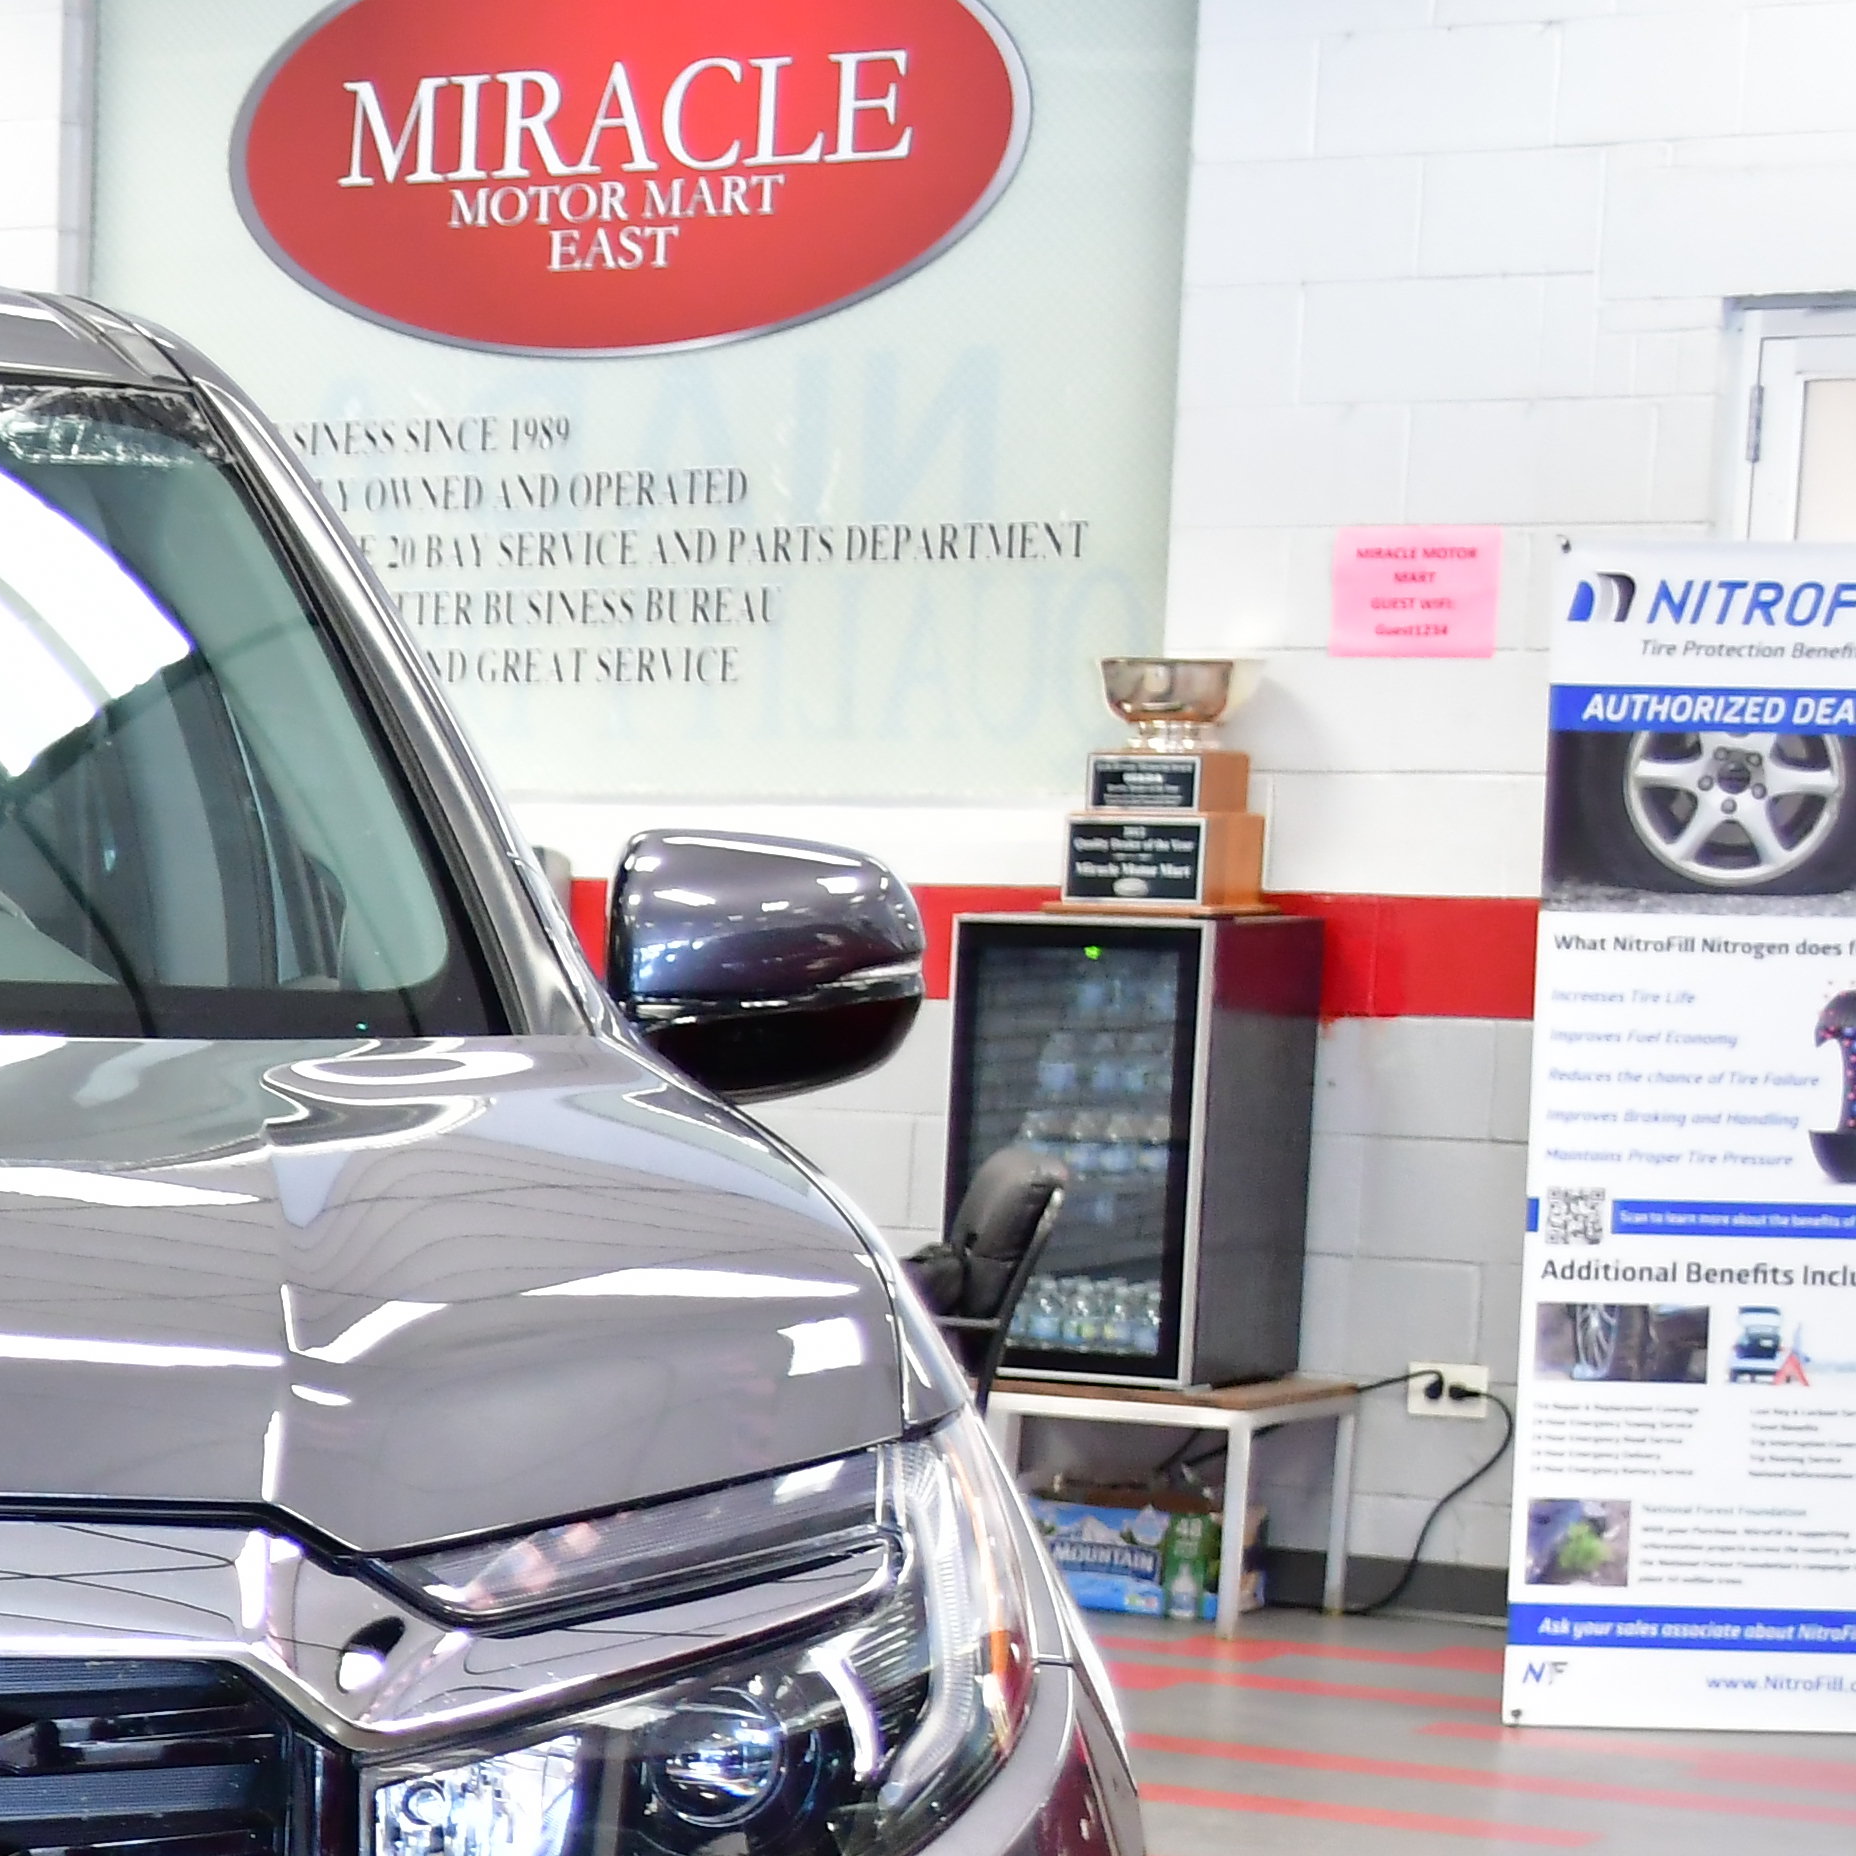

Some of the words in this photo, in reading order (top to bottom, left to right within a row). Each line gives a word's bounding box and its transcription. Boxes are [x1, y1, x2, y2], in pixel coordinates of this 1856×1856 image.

[337, 48, 913, 188] MIRACLE
[448, 181, 628, 228] MOTOR
[641, 174, 786, 220] MART
[547, 225, 679, 273] EAST
[280, 420, 395, 456] SINESS
[405, 416, 498, 454] SINCE
[511, 416, 571, 452] 1989
[365, 474, 484, 512] OWNED
[497, 472, 559, 510] AND
[570, 467, 748, 510] OPERATED
[386, 534, 416, 569] 20
[427, 532, 486, 568] BAY
[499, 528, 638, 568] SERVICE
[651, 526, 716, 566] AND
[728, 523, 834, 563] PARTS
[846, 520, 1089, 562] DEPARTMENT
[1356, 547, 1417, 559] MIRACLE
[1422, 547, 1478, 559] MOTOR
[1394, 571, 1436, 583] MART
[484, 588, 635, 627] BUSINESS
[646, 585, 780, 625] BUREAU
[1370, 597, 1415, 610] GUEST
[1641, 639, 1677, 656] Tire
[1683, 640, 1785, 658] Protection
[477, 646, 587, 684] GREAT
[597, 645, 740, 684] SERVICE
[1582, 693, 1786, 724] AUTHORIZED
[1554, 934, 1606, 951] What
[1613, 935, 1695, 953] NitroFill
[1702, 937, 1789, 960] Nitrogen
[1796, 938, 1842, 956] does
[1551, 989, 1624, 1004] Increases
[1631, 989, 1659, 1005] Tire
[1664, 990, 1695, 1005] Life
[1550, 1028, 1621, 1045] Improves
[1627, 1029, 1661, 1044] Fuel
[1664, 1030, 1738, 1048] Economy
[1548, 1067, 1611, 1083] Reduces
[1617, 1068, 1642, 1083] the
[1647, 1069, 1703, 1085] chance
[1729, 1071, 1758, 1086] Tire
[1763, 1071, 1820, 1087] Failure
[1627, 1149, 1681, 1166] Proper
[1687, 1150, 1717, 1165] Tire
[1722, 1151, 1794, 1166] Pressure
[1541, 1259, 1677, 1284] Additional
[1687, 1262, 1794, 1287] Benefits
[1054, 1542, 1154, 1573] MOUNTAIN
[1538, 1615, 1568, 1636] Ask
[1572, 1620, 1614, 1641] your
[1616, 1618, 1658, 1638] sales
[1661, 1619, 1740, 1640] associate
[1744, 1622, 1795, 1642] about
